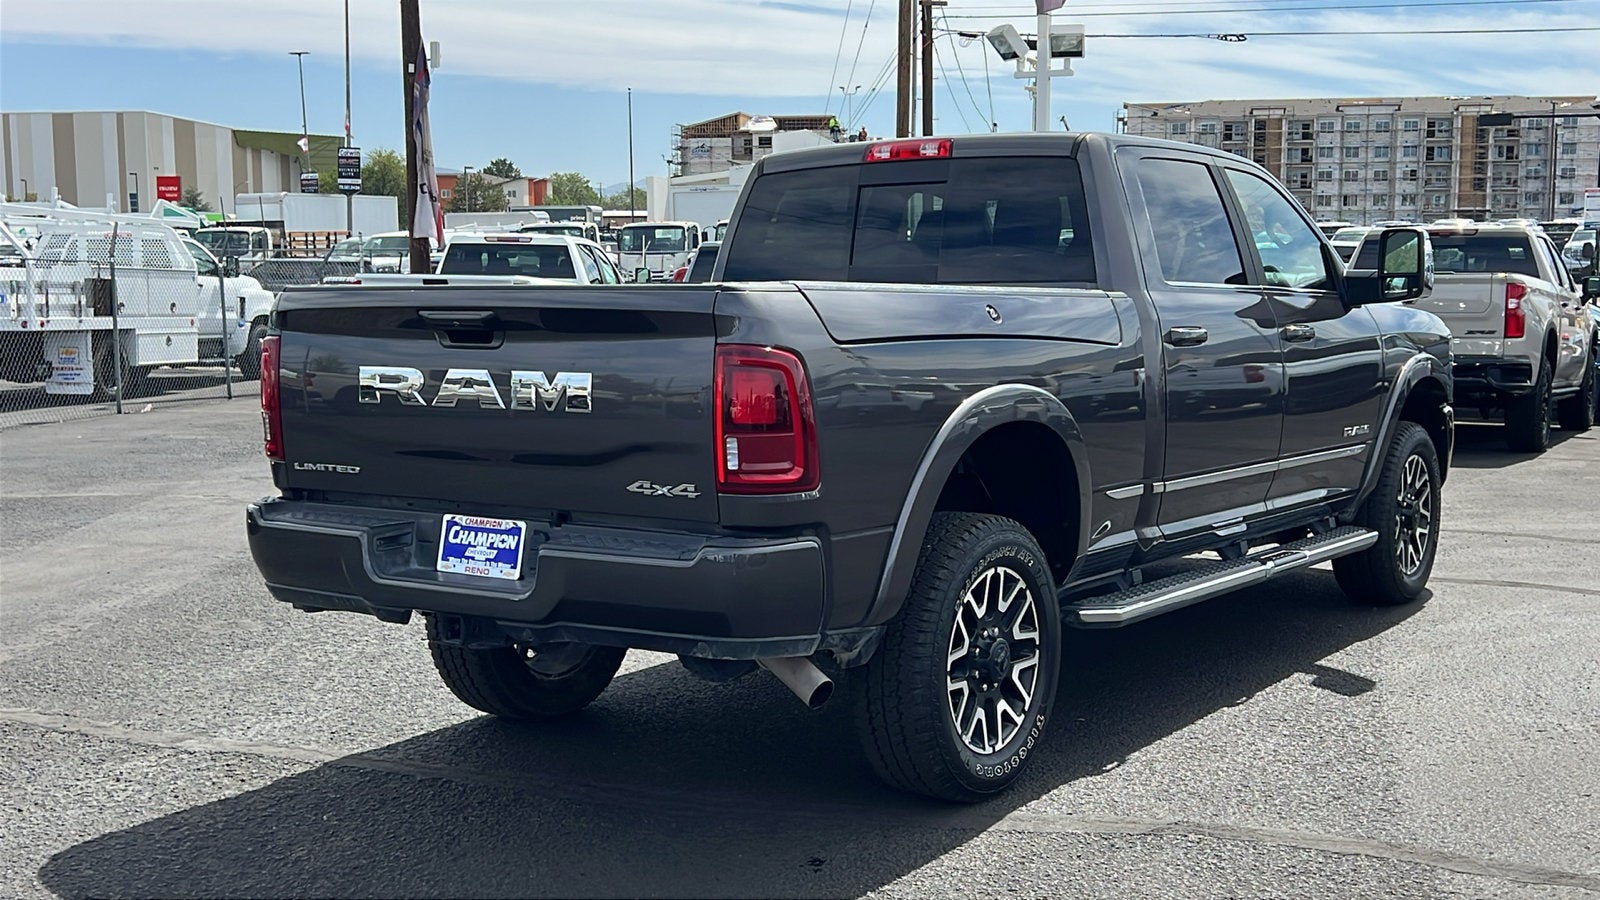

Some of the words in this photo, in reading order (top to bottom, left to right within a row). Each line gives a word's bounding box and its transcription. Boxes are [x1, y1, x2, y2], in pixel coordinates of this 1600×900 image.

[359, 366, 593, 413] RAM
[294, 462, 361, 474] LIMITED
[626, 480, 701, 498] 4x4
[464, 518, 503, 528] CHAMPION
[448, 525, 519, 550] CHAMPION
[464, 566, 490, 576] RENO
